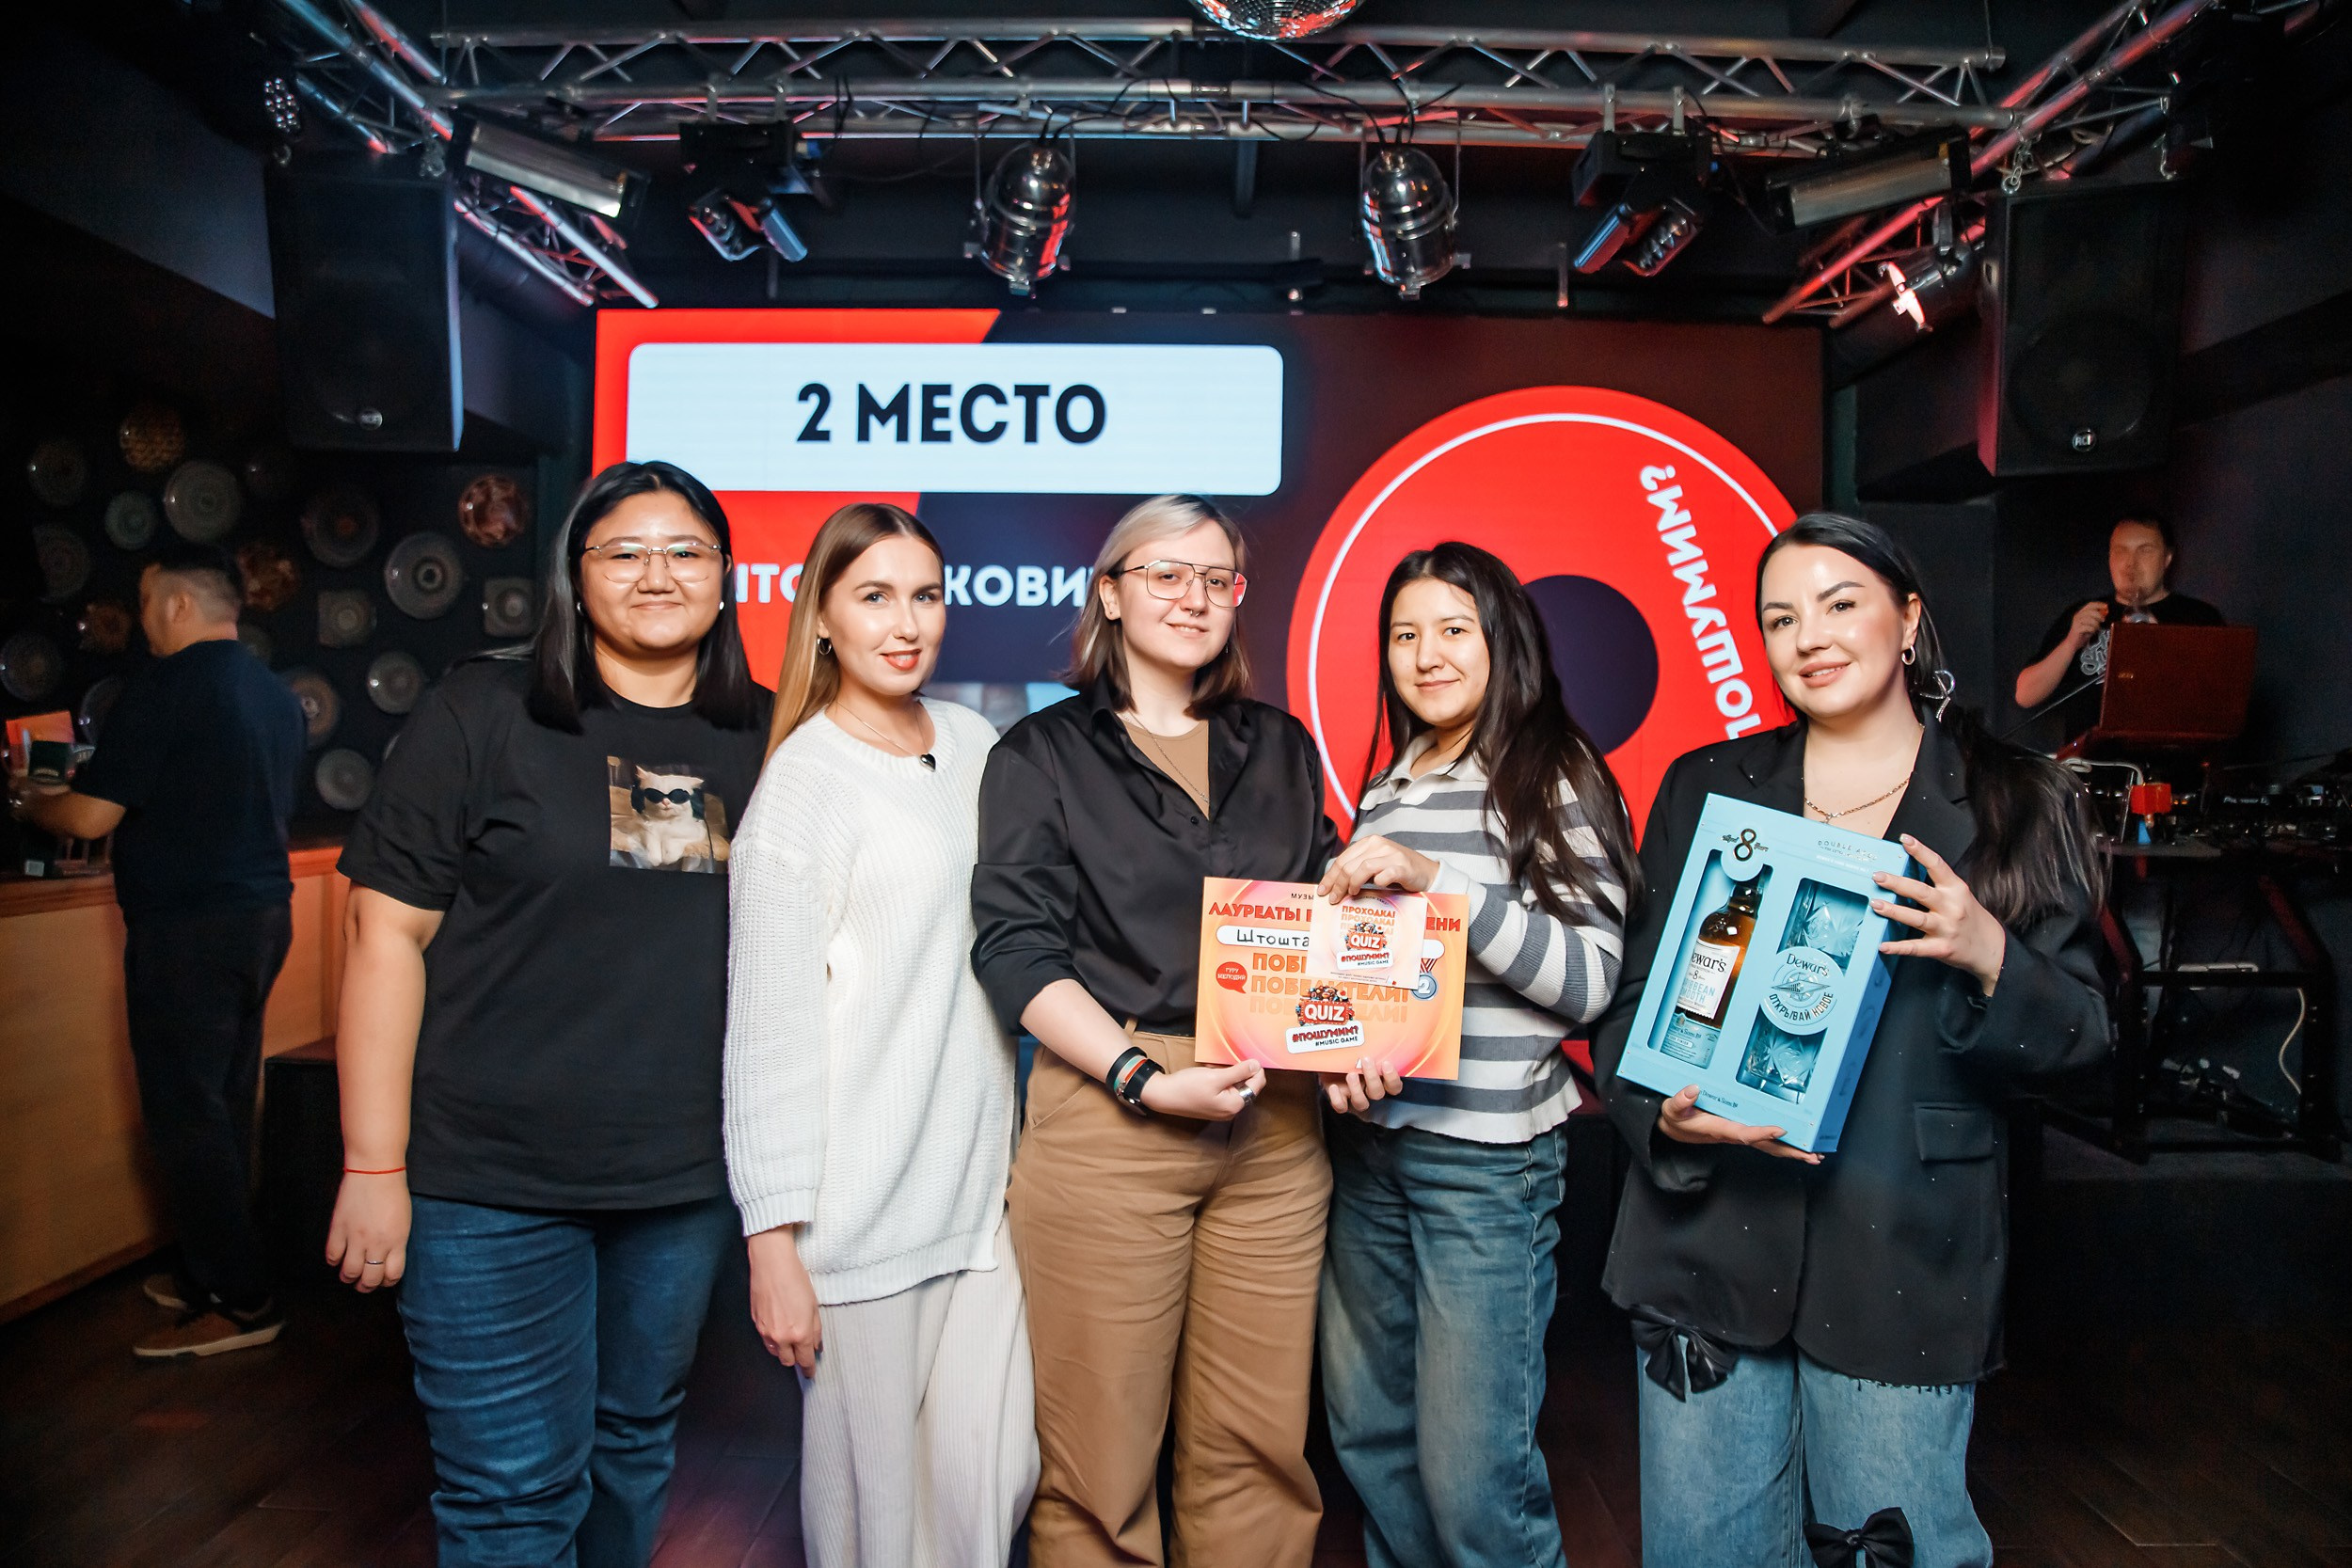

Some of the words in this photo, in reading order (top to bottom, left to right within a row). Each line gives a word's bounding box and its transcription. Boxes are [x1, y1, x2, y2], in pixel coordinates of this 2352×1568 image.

[797, 382, 831, 442] 2
[856, 382, 1106, 444] МЕСТО
[1733, 828, 1756, 862] 8
[1208, 901, 1301, 922] ЛАУРЕАТЫ
[1425, 916, 1461, 932] ЕНИ
[1342, 905, 1396, 919] ПРОХОДКА!
[1236, 929, 1310, 947] Штошта
[1350, 934, 1381, 949] QUIZ
[1691, 952, 1727, 973] ewar's
[1418, 978, 1431, 994] 2
[1304, 1004, 1345, 1022] QUIZ
[1769, 993, 1811, 1022] ОТКРЫВАЙ
[1811, 991, 1834, 1018] НОВОЕ
[1292, 1025, 1359, 1043] #ПОШУМИМ?
[1315, 1037, 1340, 1047] #MUSIC
[1340, 1036, 1359, 1044] GAME
